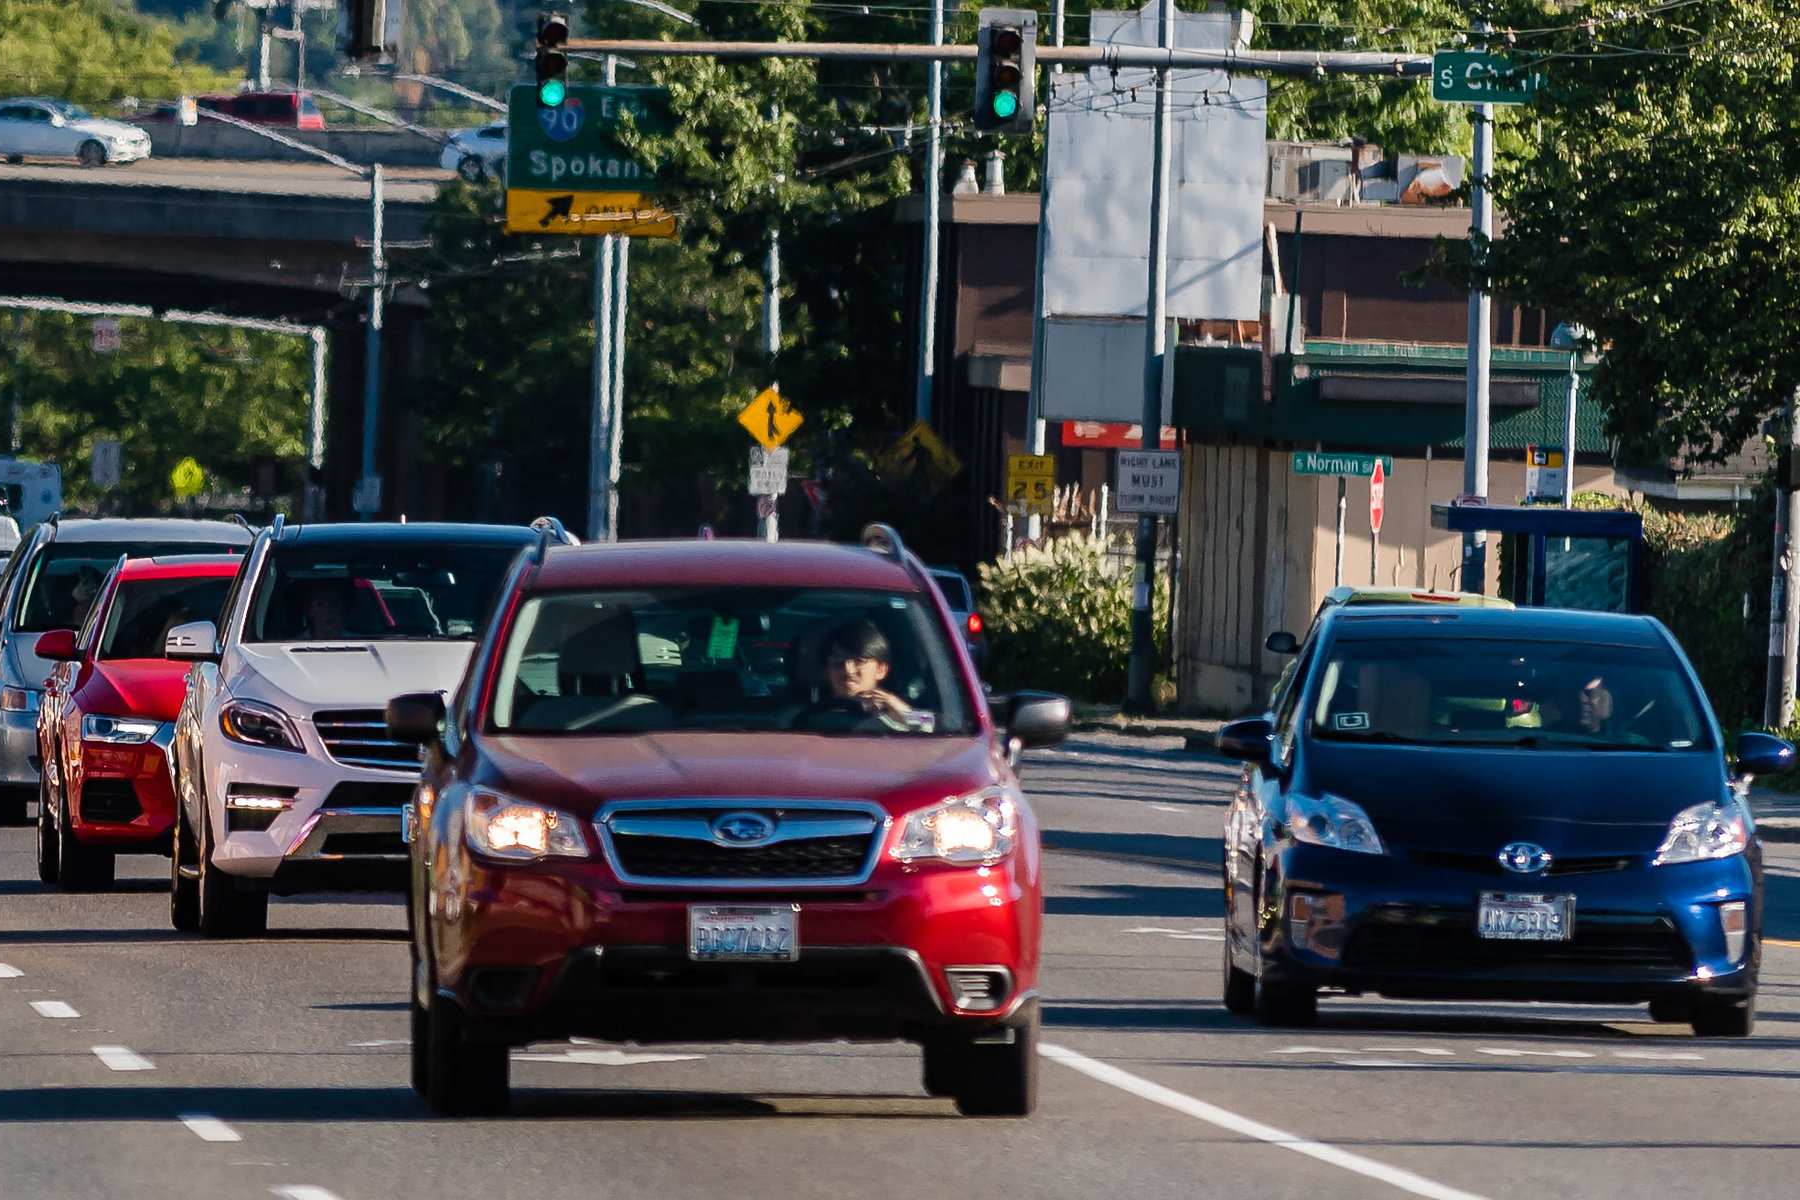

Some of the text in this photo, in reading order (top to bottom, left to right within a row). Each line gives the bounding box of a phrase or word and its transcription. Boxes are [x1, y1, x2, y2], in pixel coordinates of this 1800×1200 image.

[1440, 67, 1454, 90] S
[542, 109, 578, 132] 90
[529, 150, 642, 182] Spokan
[1018, 459, 1045, 470] EXIT
[1307, 453, 1359, 473] Norman
[1131, 473, 1163, 488] MUST
